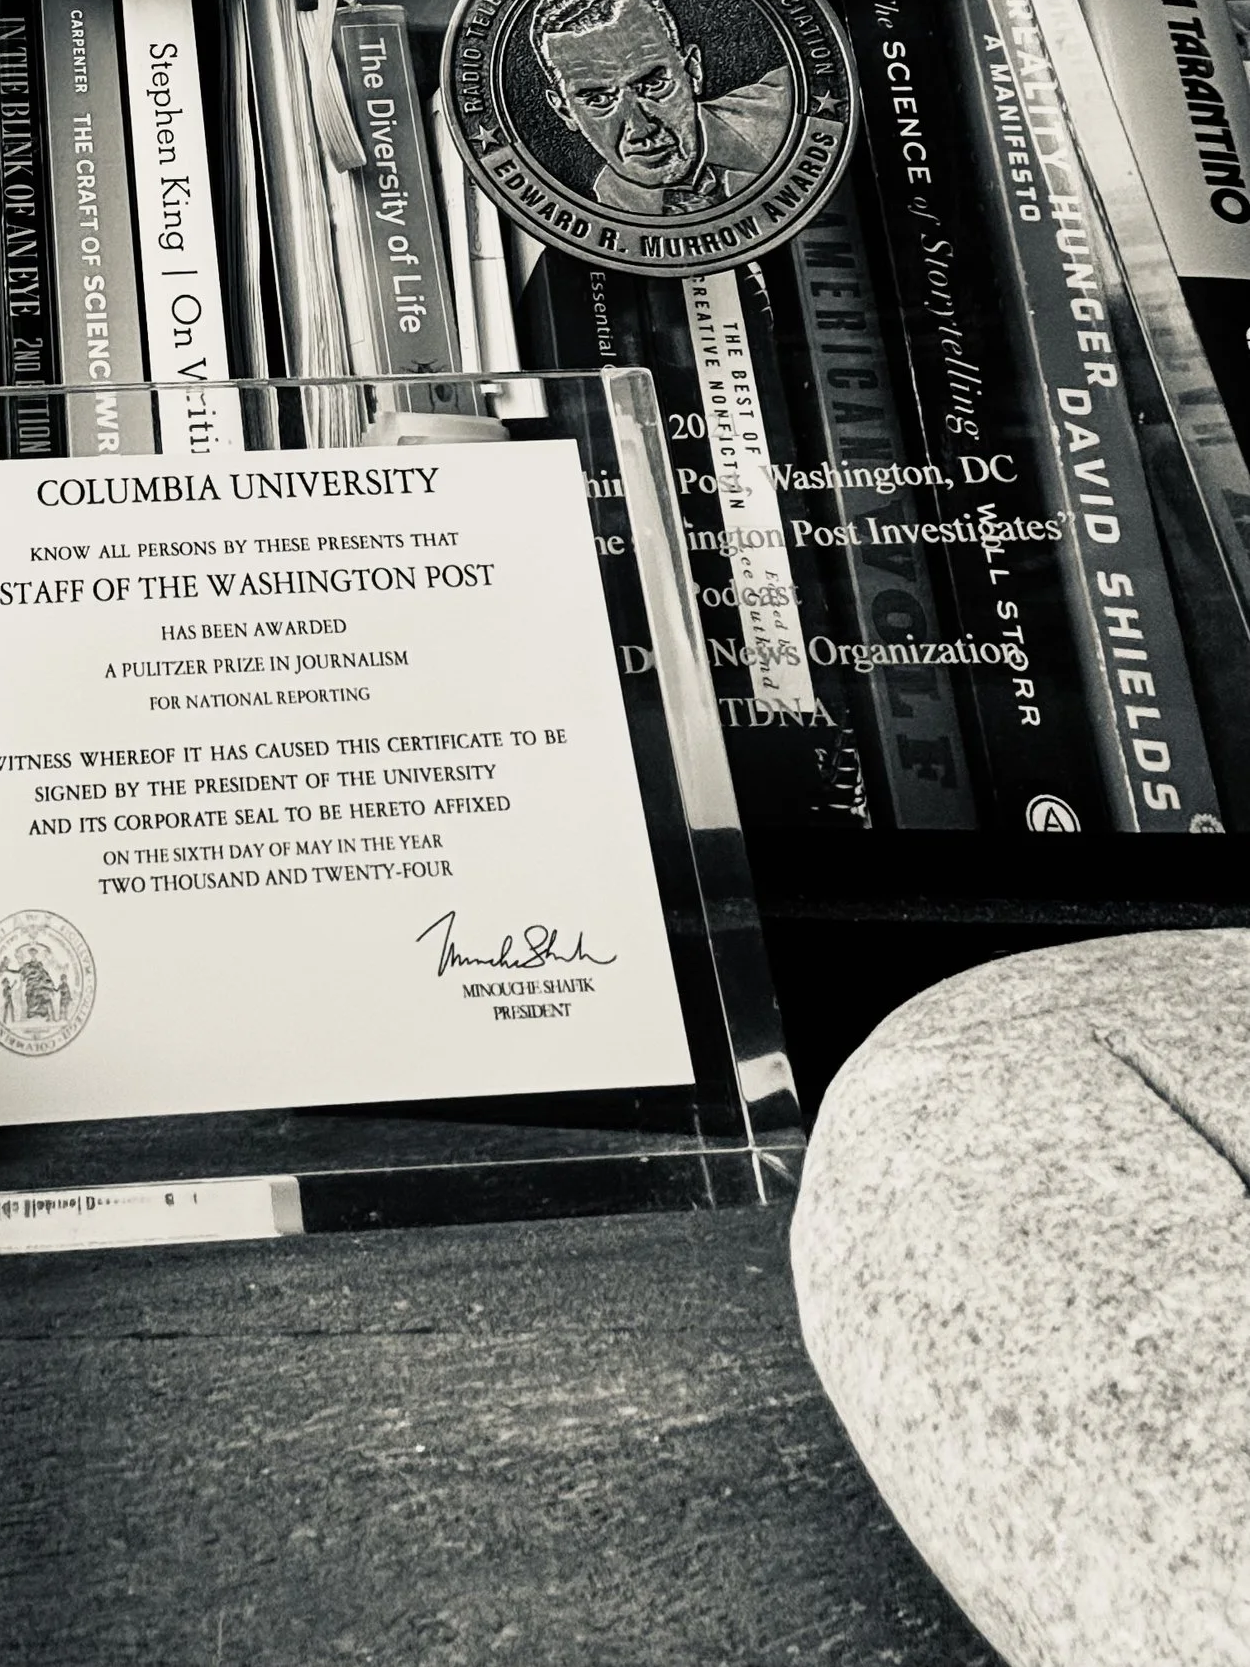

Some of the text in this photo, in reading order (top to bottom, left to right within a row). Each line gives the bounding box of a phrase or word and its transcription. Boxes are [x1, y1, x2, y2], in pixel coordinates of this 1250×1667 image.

[463, 45, 484, 115] RADIO
[881, 39, 934, 186] SCIENCE
[981, 32, 1043, 223] A MANIFESTO
[1166, 16, 1250, 226] TARANTINO
[69, 8, 113, 388] CARPENTER THE CRAFT OF SCIENC
[146, 42, 203, 350] Stephen King On
[357, 37, 428, 335] The Diversity of Life
[491, 130, 840, 260] EDWARD R. MURROW AWARDS
[906, 194, 942, 228] of
[590, 271, 618, 357] Essential
[919, 232, 984, 441] Storytelling
[1046, 194, 1120, 389] HUNGER
[36, 466, 440, 507] COLUMBIA UNIVERSITY
[757, 459, 956, 499] Washington,
[958, 453, 1020, 486] DC
[1056, 387, 1123, 545] DAVID
[0, 562, 495, 606] STAFF OF THE WASHINGTON POST
[104, 649, 410, 680] A PULITZER PRIZE IN JOURNALISM
[149, 686, 371, 711] FOR NATIONAL REPORTING
[1096, 569, 1183, 812] SHIELDS
